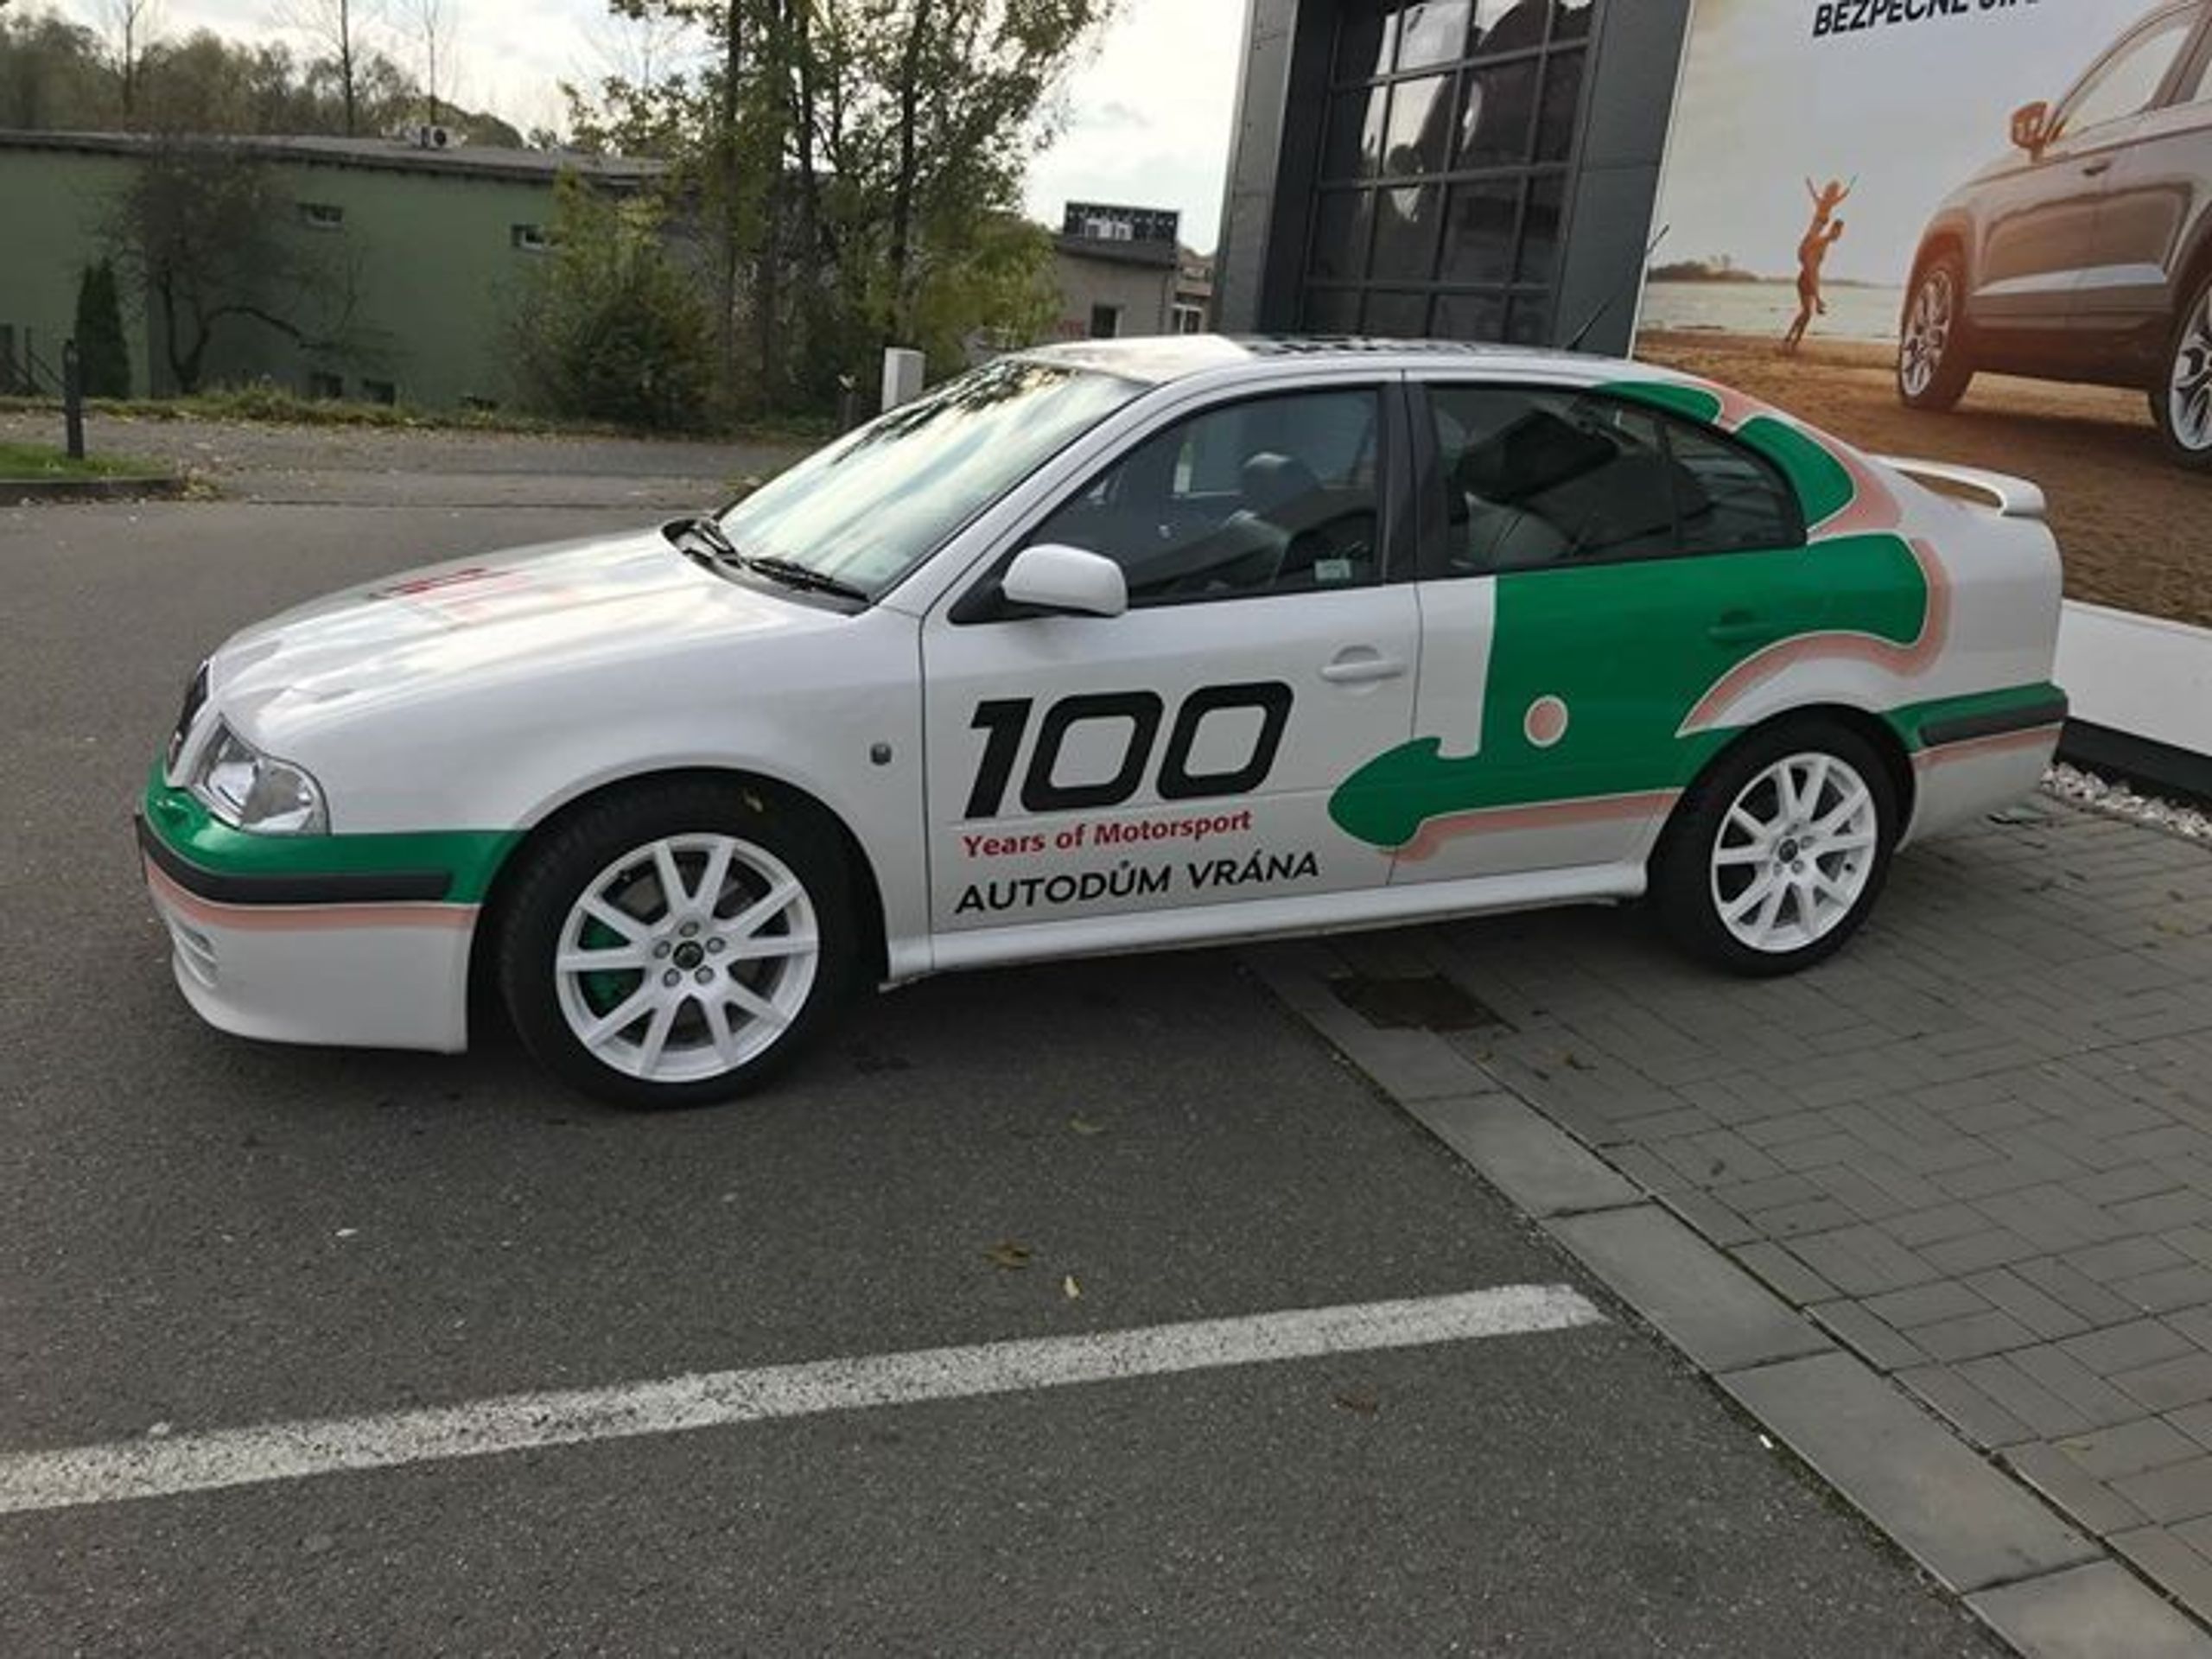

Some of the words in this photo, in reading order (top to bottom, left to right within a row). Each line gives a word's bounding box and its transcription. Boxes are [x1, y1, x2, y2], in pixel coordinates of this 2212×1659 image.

[963, 680, 1294, 818] 100
[963, 835, 1046, 858] Years
[1056, 824, 1084, 849] of
[1094, 810, 1252, 845] Motorsport
[1187, 850, 1319, 890] VRÁNA
